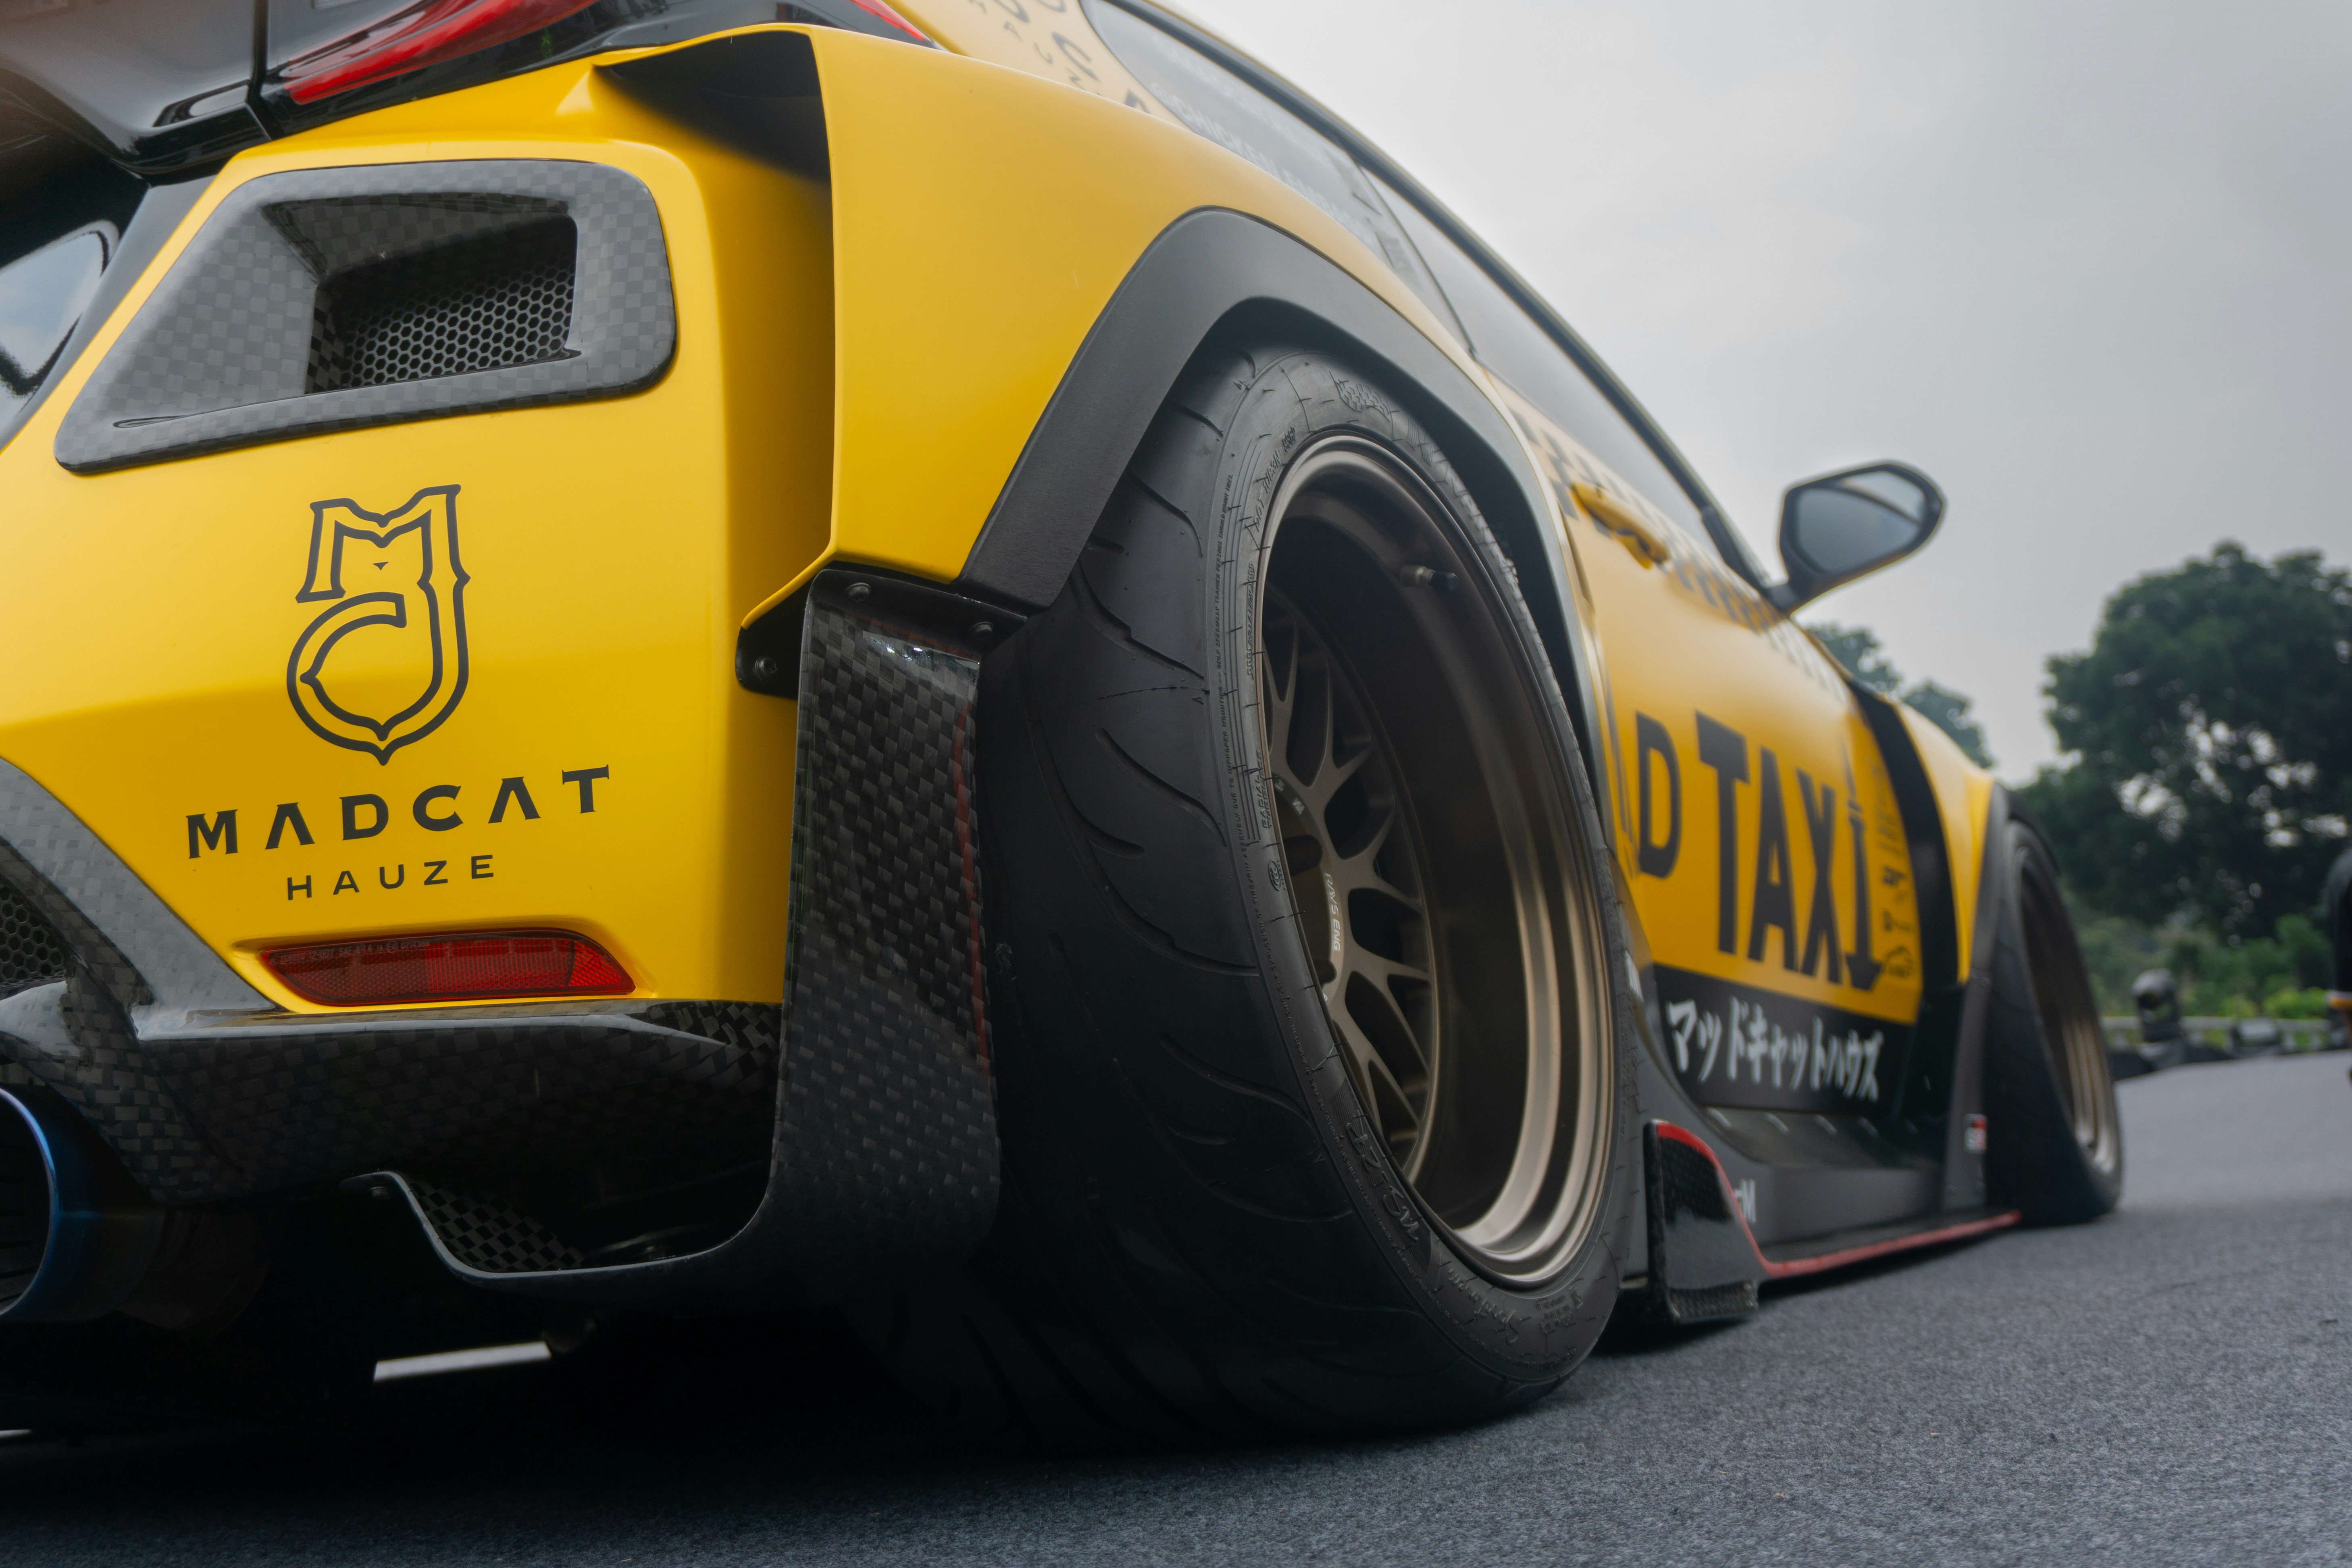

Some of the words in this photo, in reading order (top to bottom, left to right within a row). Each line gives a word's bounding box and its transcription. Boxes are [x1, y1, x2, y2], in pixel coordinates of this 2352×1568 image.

[186, 764, 610, 859] MADCAT
[1695, 709, 1885, 992] TAXI
[286, 854, 495, 901] HAUZE
